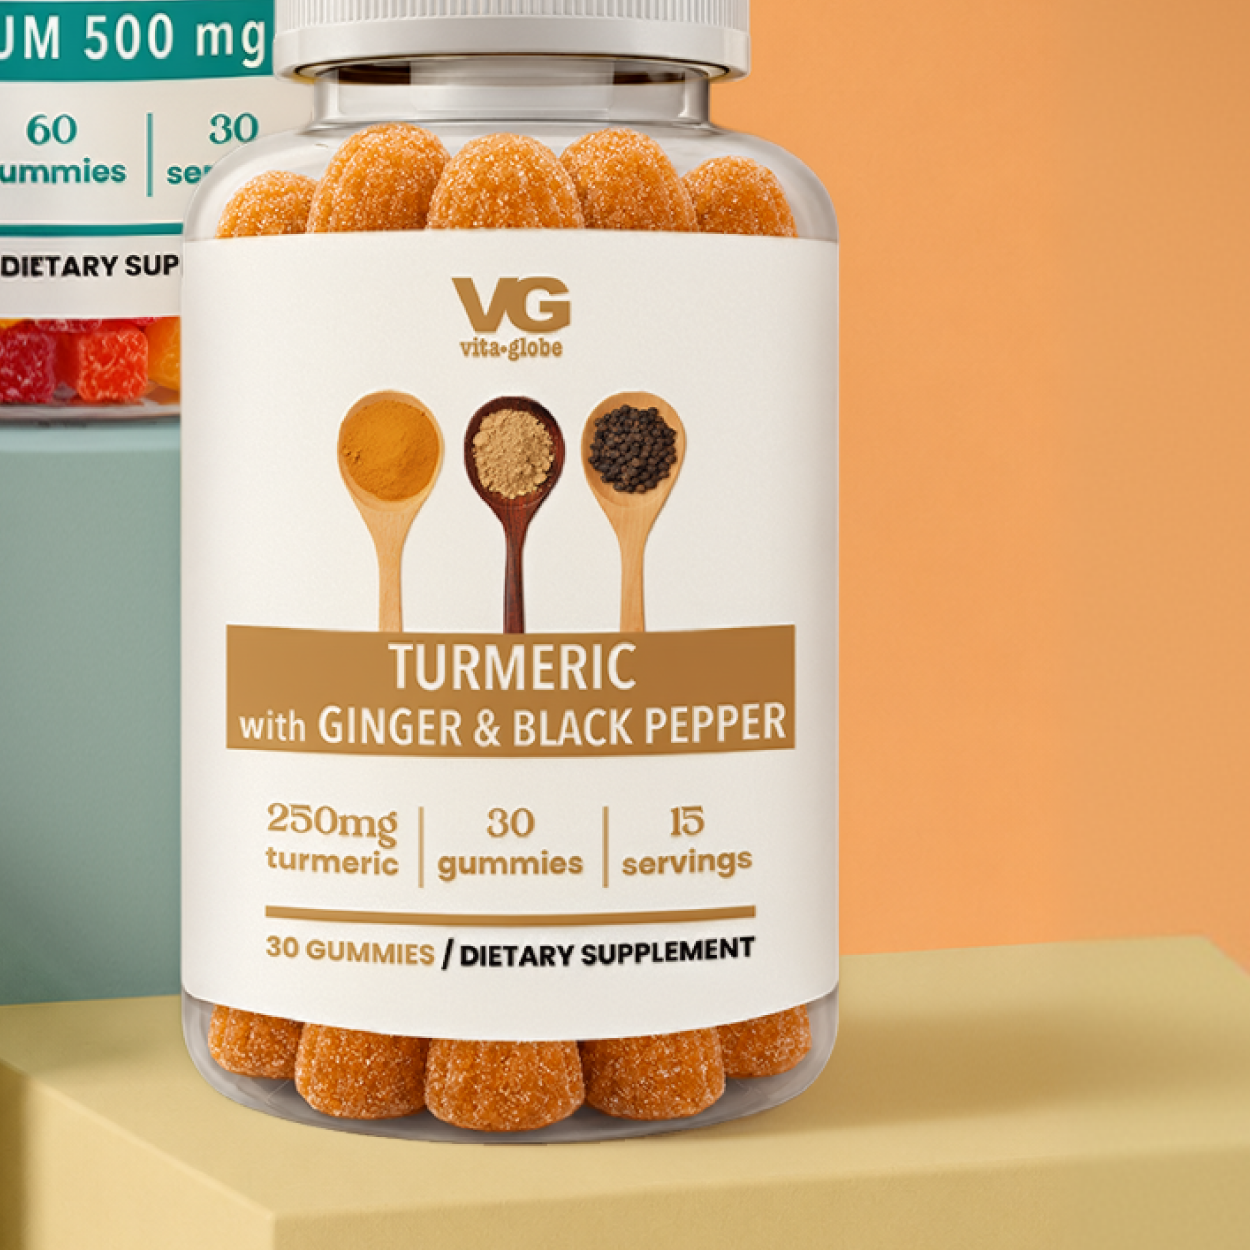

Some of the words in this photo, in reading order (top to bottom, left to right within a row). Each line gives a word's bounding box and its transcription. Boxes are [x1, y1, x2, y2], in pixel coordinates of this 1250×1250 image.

[84, 13, 173, 59] 500
[197, 22, 264, 68] mg
[27, 114, 77, 145] 60
[210, 113, 258, 144] 30
[1, 255, 118, 277] DIETARY
[452, 277, 570, 334] VG
[388, 644, 636, 690] TURMERIC
[240, 710, 305, 741] with
[319, 706, 461, 745] GINGER
[475, 709, 500, 747] &
[514, 708, 632, 746] BLACK
[646, 702, 786, 743] PEPPER
[267, 803, 398, 848] 250mg
[487, 808, 535, 838] 30
[671, 806, 704, 837] 15
[266, 846, 399, 876] turmeric
[438, 850, 583, 882] gummies
[623, 849, 752, 879] servings
[266, 936, 299, 958] 30
[307, 940, 434, 966] GUMMIES
[461, 945, 574, 967] DIETARY
[581, 936, 755, 966] SUPPLEMENT
